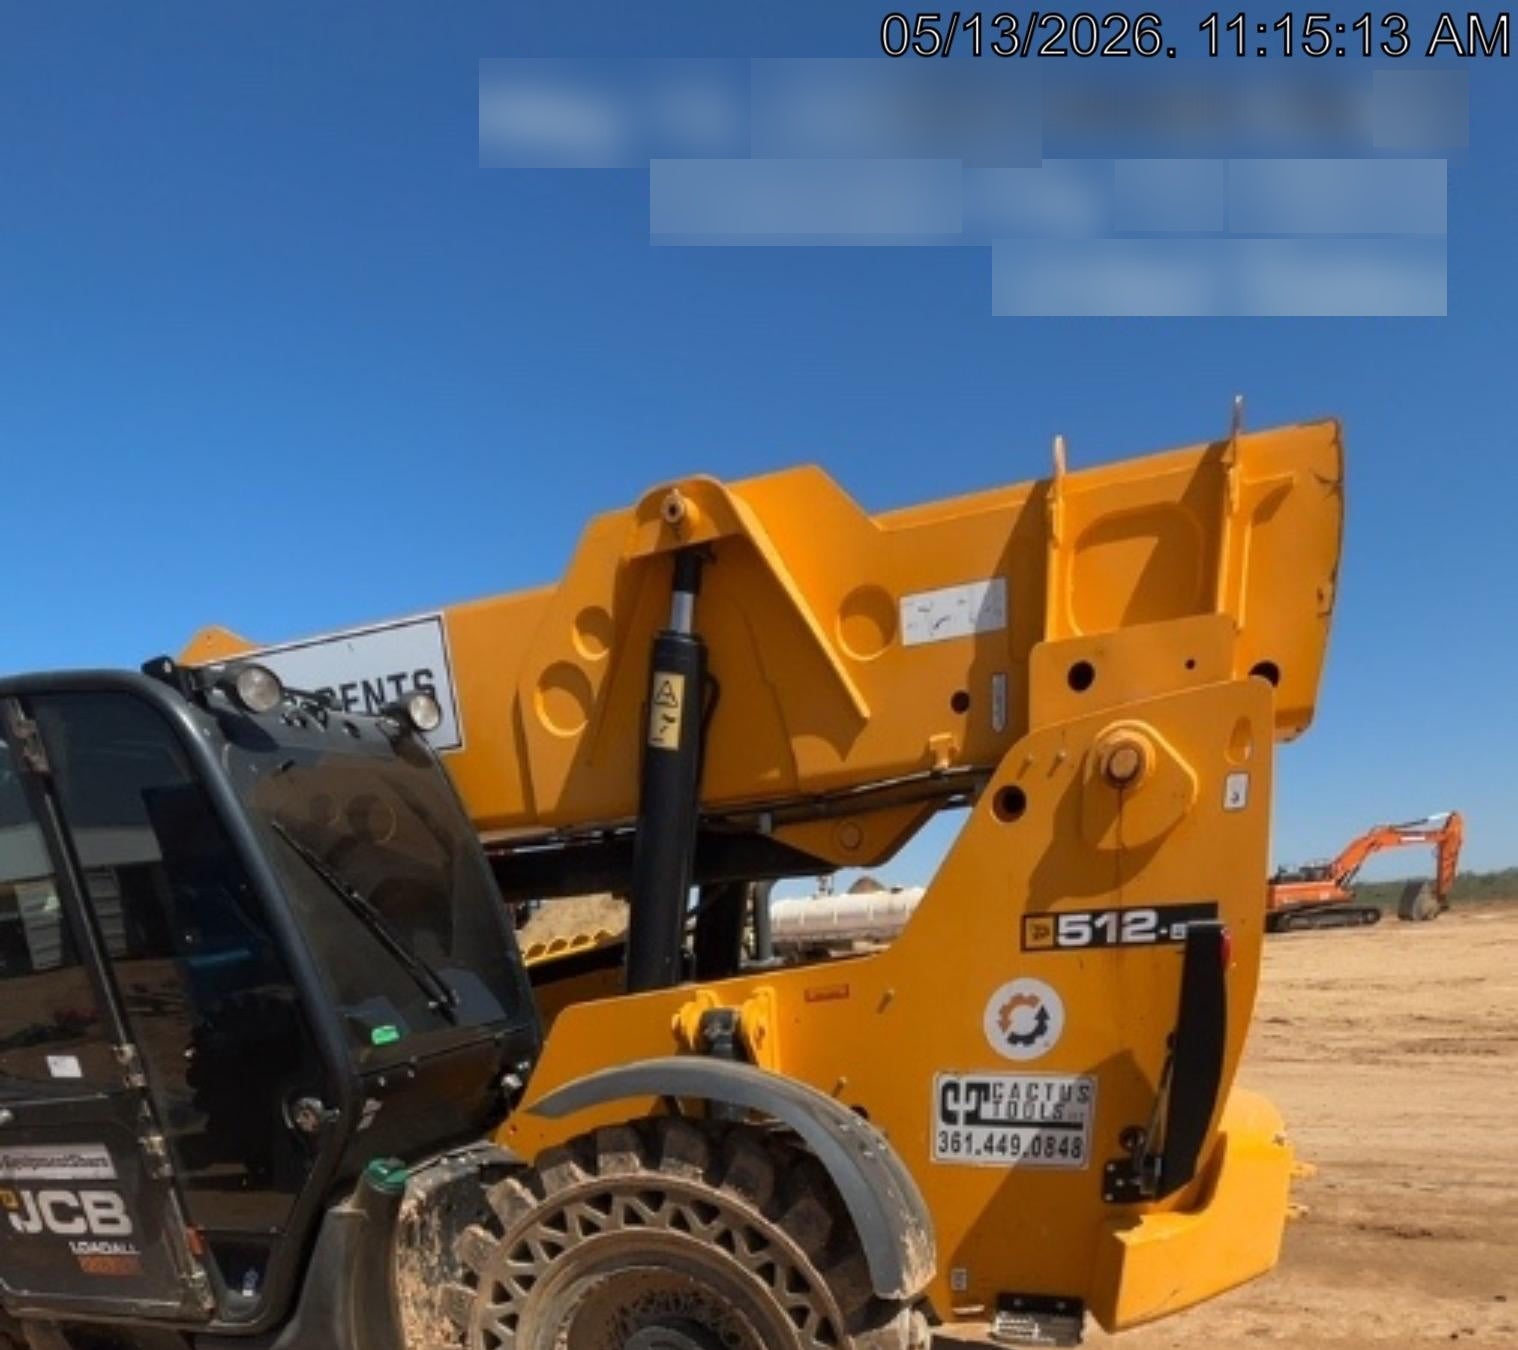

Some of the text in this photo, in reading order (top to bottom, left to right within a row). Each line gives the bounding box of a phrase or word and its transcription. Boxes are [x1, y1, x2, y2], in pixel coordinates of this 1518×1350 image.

[992, 1081, 1090, 1102] CACTUS
[992, 1101, 1065, 1120] TOOLS
[938, 1130, 1083, 1159] 361.449.0848
[9, 1190, 133, 1235] JCB
